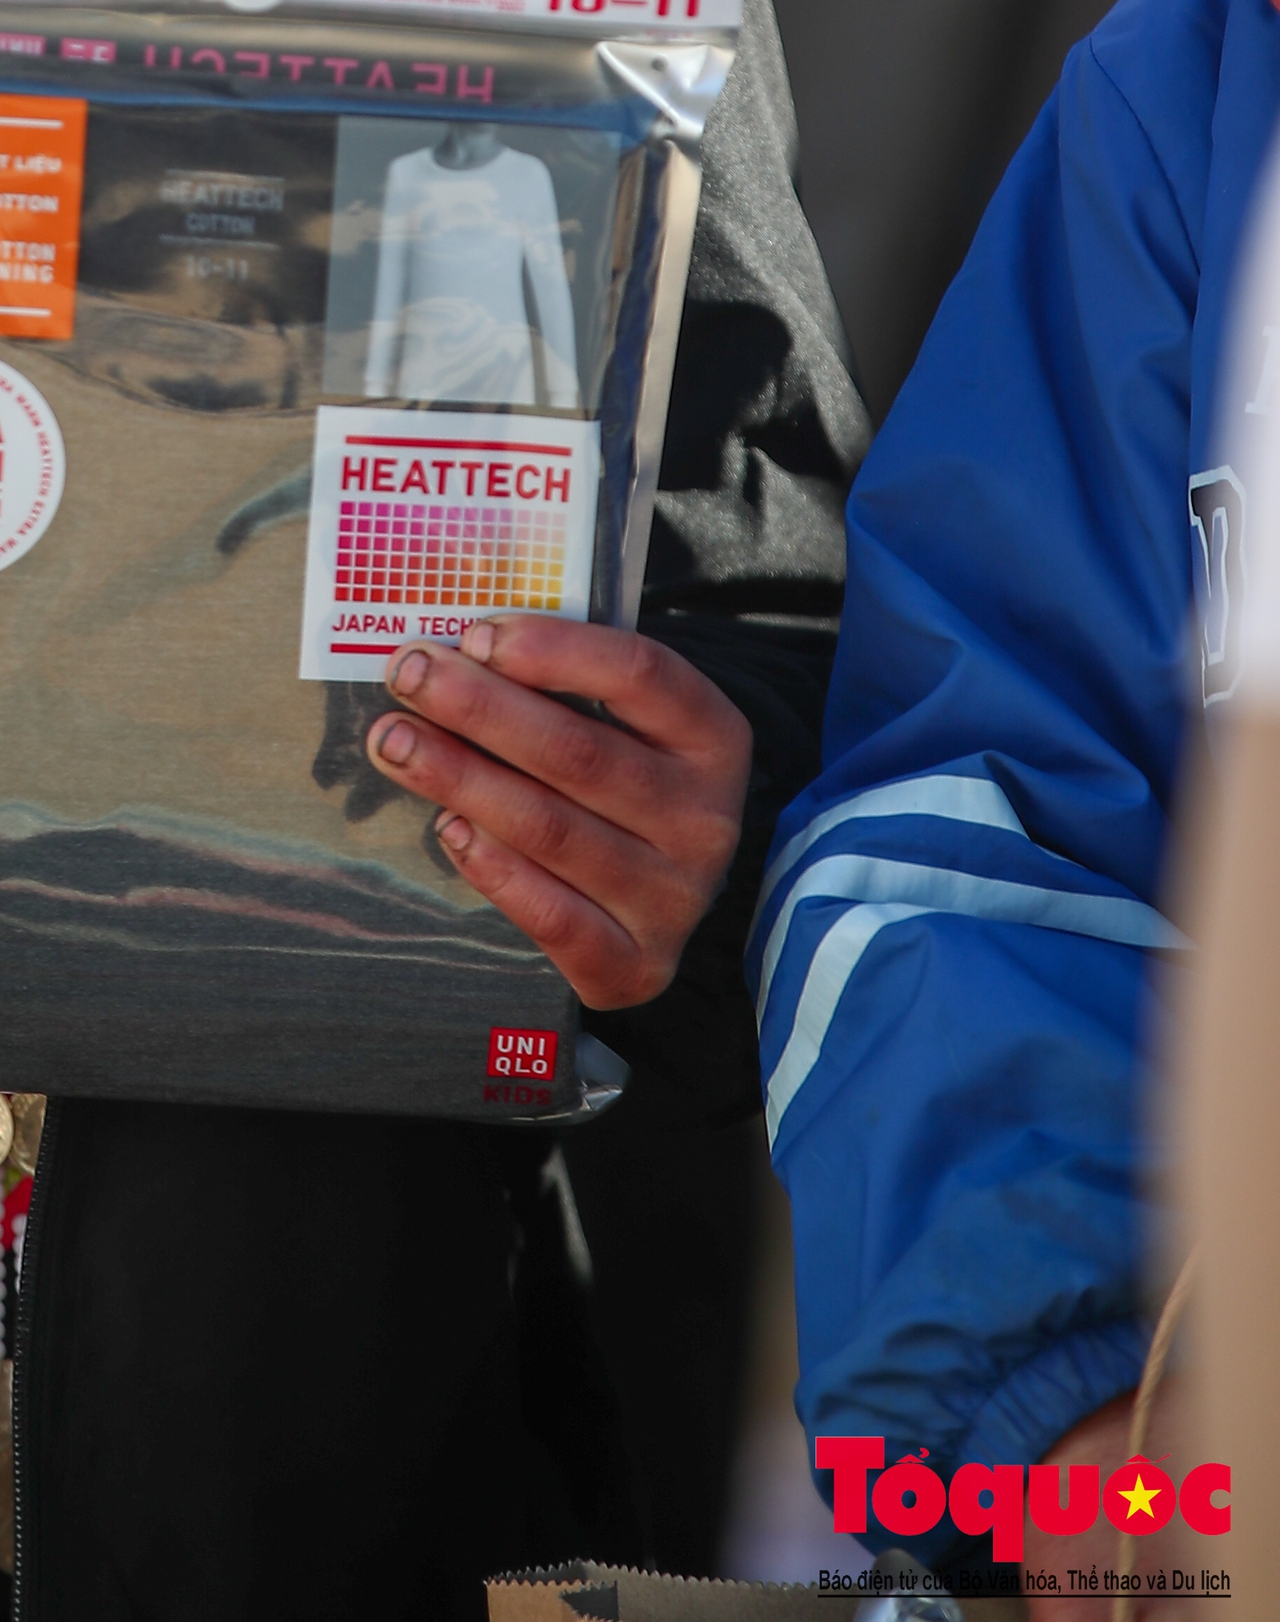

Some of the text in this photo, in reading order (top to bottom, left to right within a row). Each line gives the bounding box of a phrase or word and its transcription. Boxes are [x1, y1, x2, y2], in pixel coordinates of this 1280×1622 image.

[340, 455, 570, 503] HEATTECH
[332, 614, 479, 636] JAPAN TECH
[497, 1035, 545, 1056] UNI
[495, 1057, 548, 1075] QLO
[483, 1084, 552, 1105] KIDS
